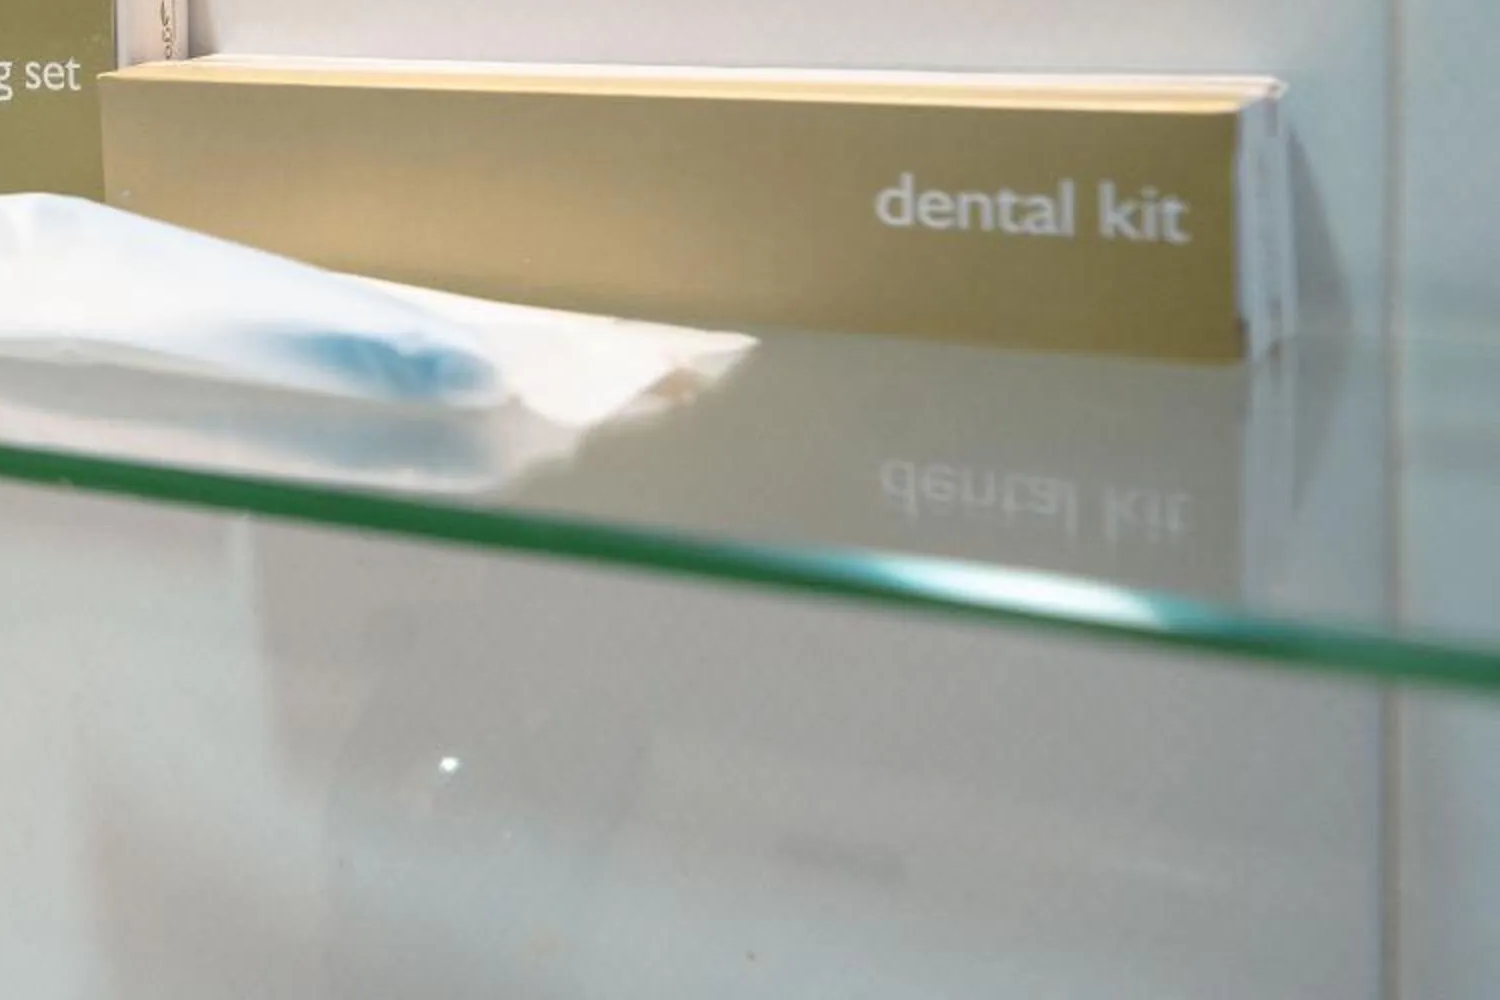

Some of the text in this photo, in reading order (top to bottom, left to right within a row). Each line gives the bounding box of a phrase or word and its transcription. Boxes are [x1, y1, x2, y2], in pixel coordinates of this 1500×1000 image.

[25, 58, 82, 91] set
[875, 172, 1192, 245] dental kit
